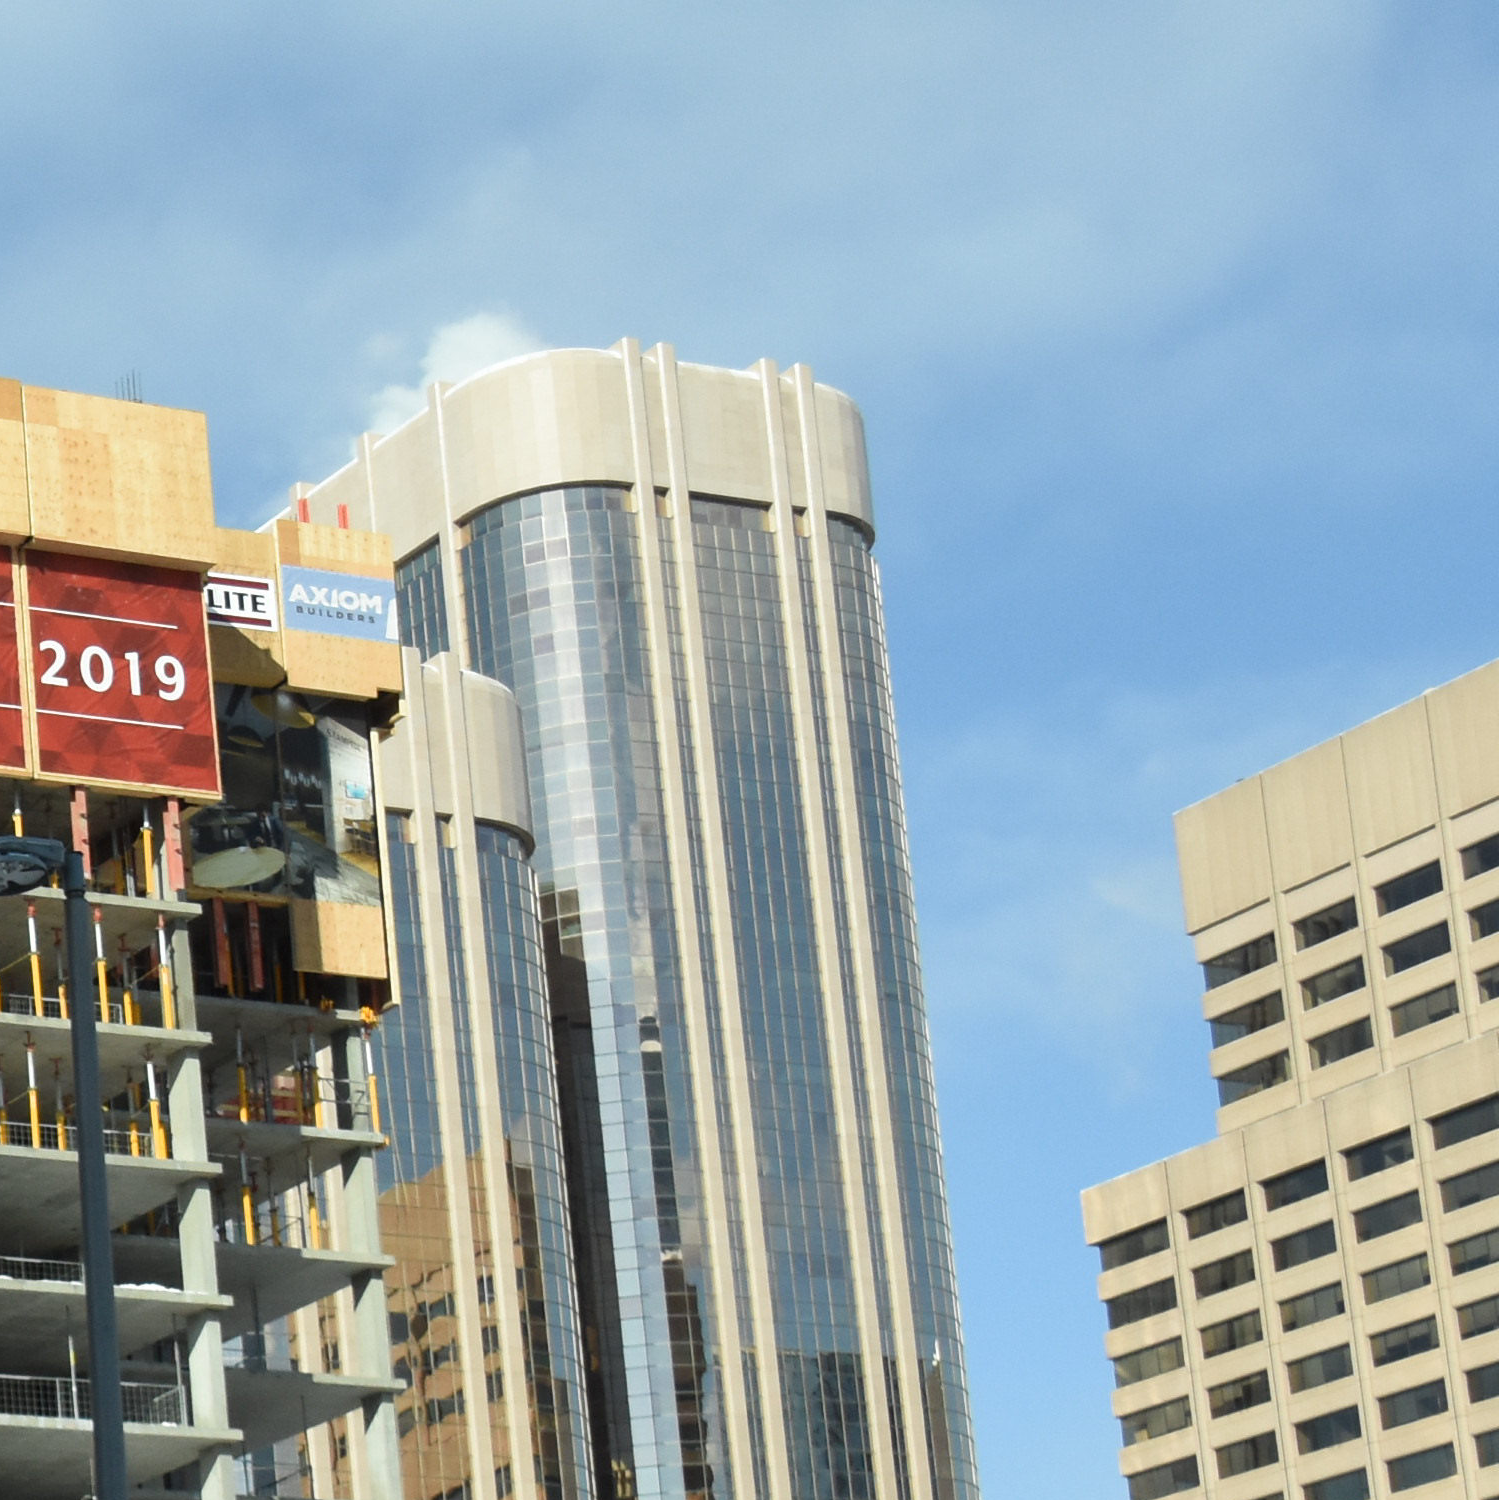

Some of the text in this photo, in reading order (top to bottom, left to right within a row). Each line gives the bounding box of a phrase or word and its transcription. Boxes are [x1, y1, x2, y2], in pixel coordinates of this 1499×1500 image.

[206, 588, 267, 613] LITE
[288, 583, 383, 615] AXIOM
[296, 605, 376, 624] BUILDERS
[38, 639, 186, 702] 2019
